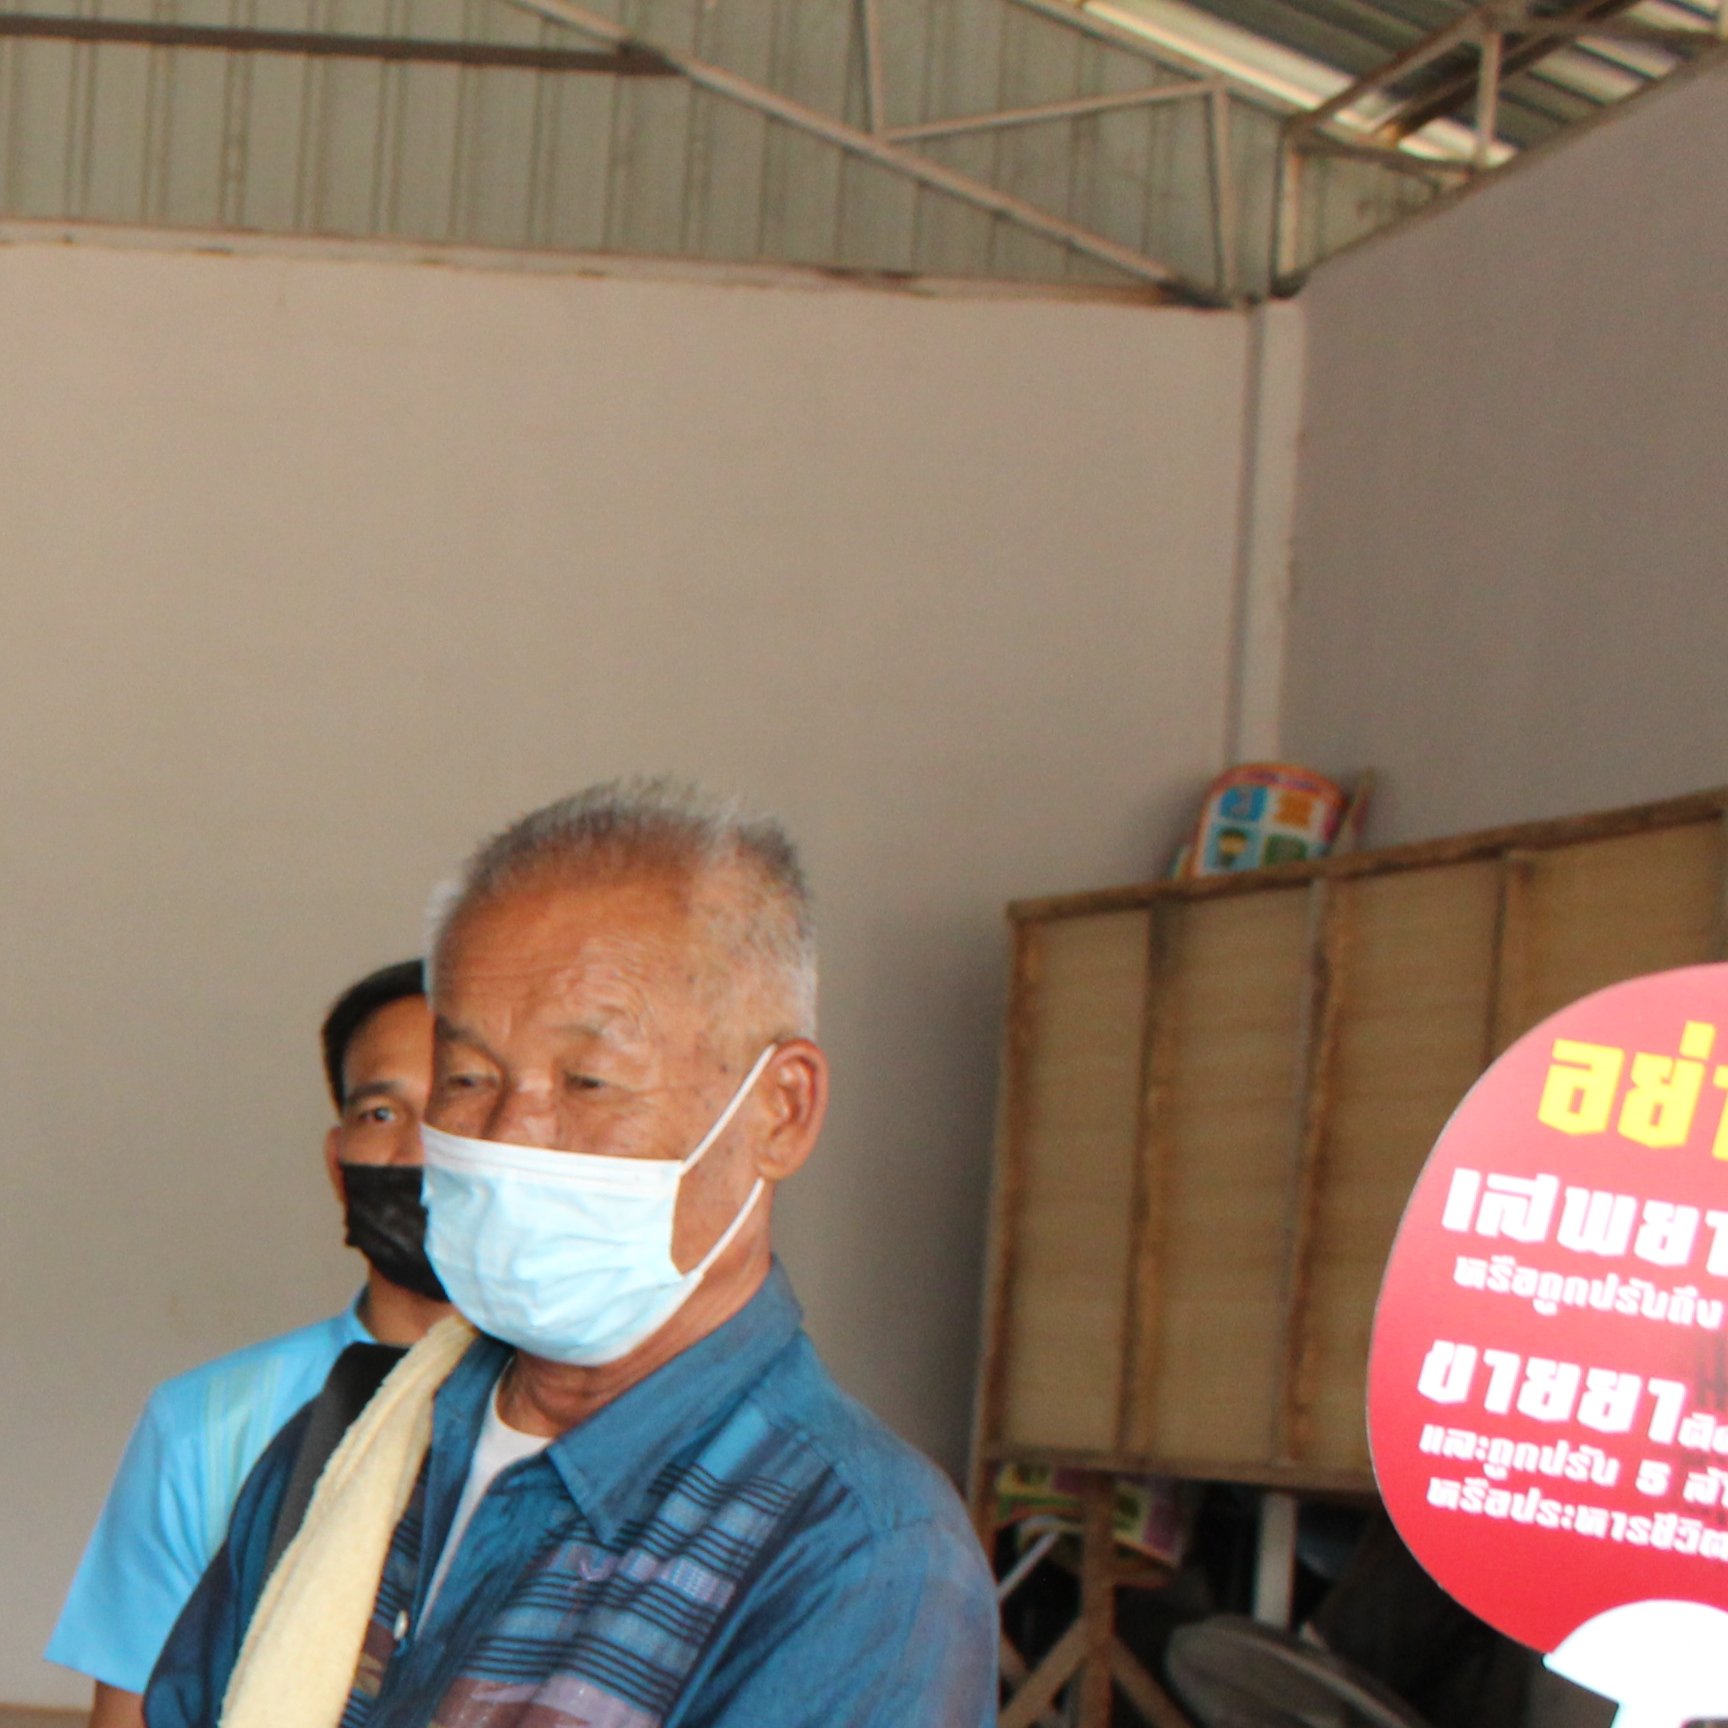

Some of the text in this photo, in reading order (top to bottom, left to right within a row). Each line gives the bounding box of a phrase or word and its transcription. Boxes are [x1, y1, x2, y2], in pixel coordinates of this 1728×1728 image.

[1419, 1423, 1620, 1486] และถูกปรับ
[1635, 1459, 1672, 1496] 5
